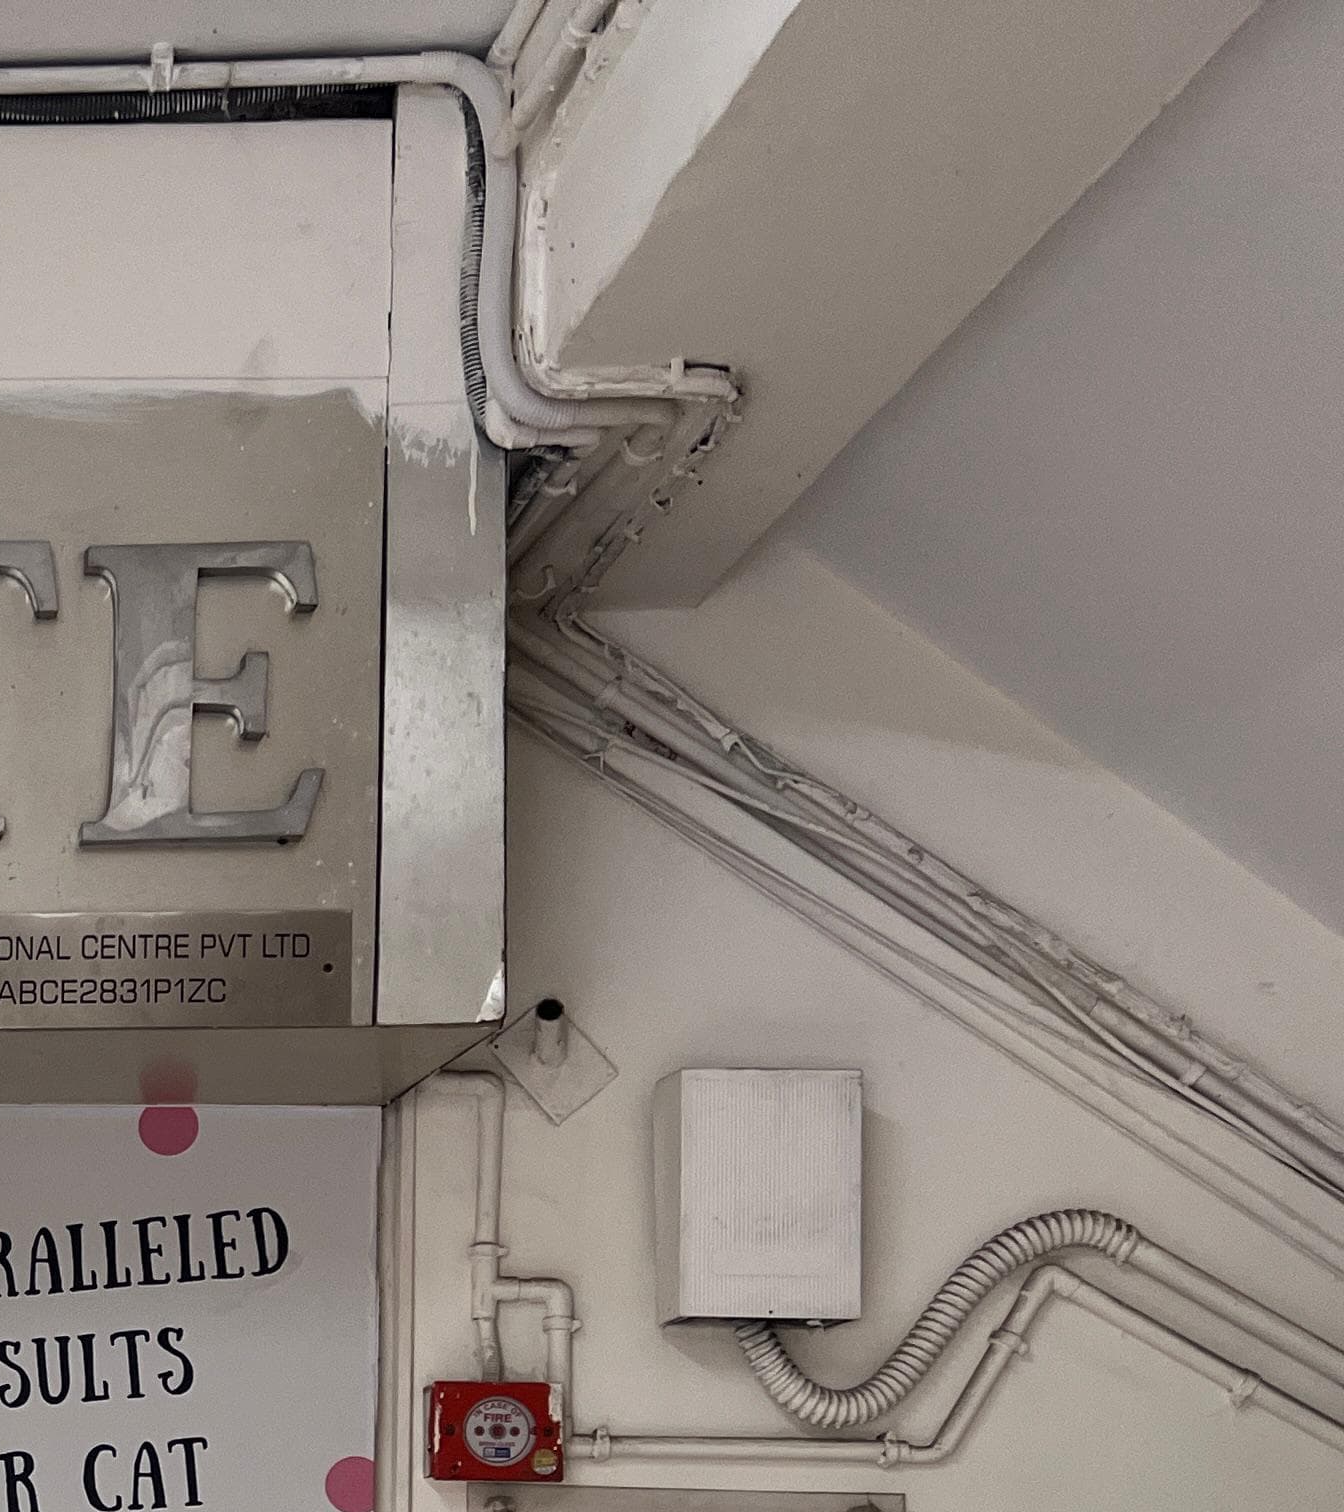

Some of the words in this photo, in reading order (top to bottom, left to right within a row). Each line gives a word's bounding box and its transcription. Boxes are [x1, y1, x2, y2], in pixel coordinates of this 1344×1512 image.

[80, 935, 189, 960] CENTRE
[200, 934, 251, 958] PVT
[263, 933, 311, 957] LTD
[484, 1414, 512, 1422] FIRE
[82, 1436, 208, 1512] CAT
